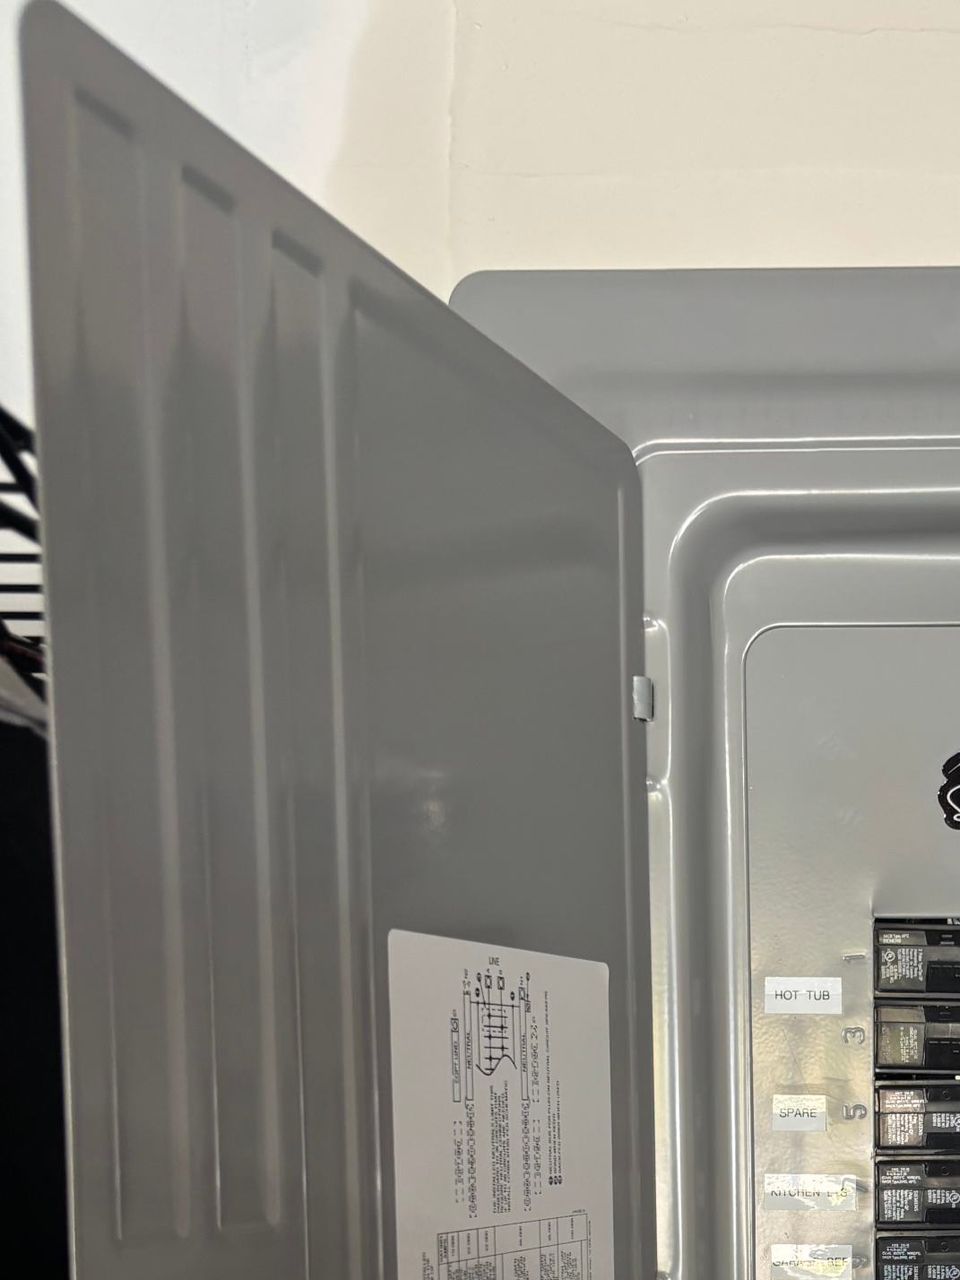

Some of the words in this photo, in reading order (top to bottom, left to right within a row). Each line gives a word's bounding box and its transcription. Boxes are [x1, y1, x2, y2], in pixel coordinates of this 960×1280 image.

[775, 990, 799, 1000] HOT
[807, 990, 830, 1001] TUB
[842, 1027, 866, 1045] 3
[779, 1108, 817, 1118] SPARE
[842, 1103, 868, 1120] 5
